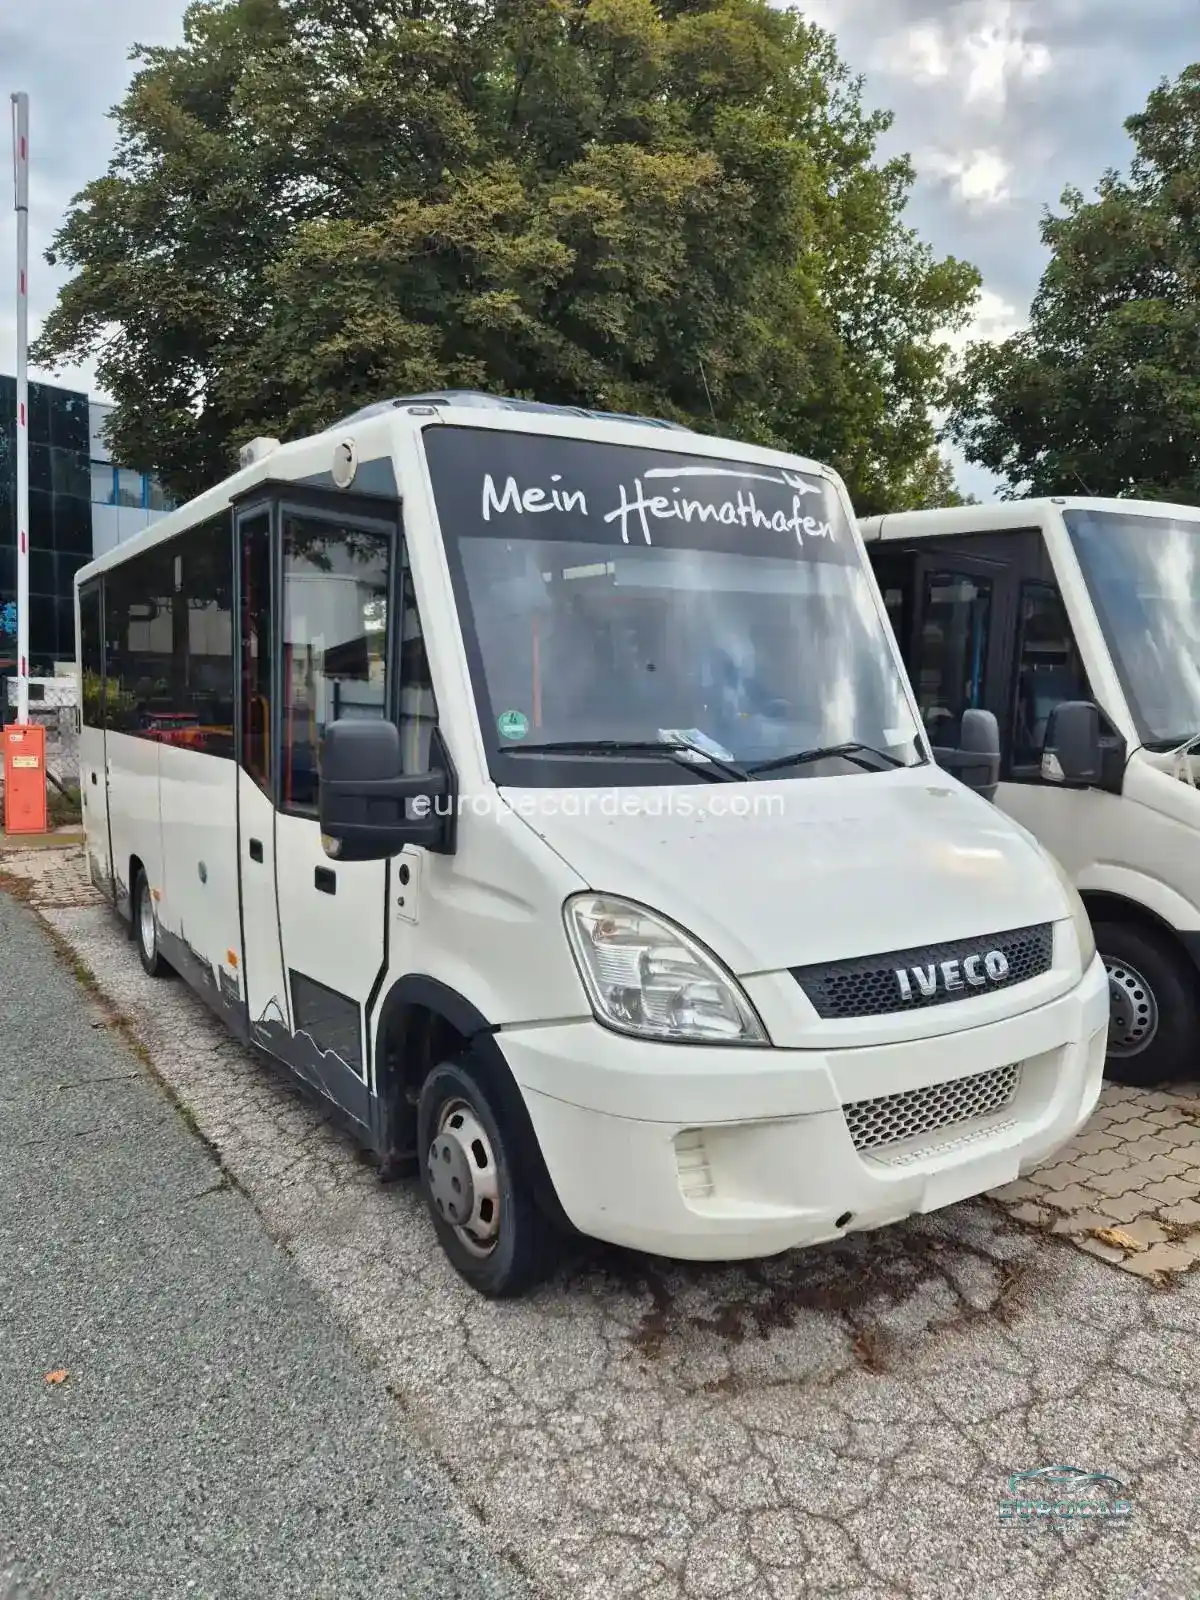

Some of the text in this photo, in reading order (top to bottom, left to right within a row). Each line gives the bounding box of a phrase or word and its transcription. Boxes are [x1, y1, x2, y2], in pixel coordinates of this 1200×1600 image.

[482, 474, 836, 545] Mein Heimathafen
[896, 950, 1010, 1000] IVECO
